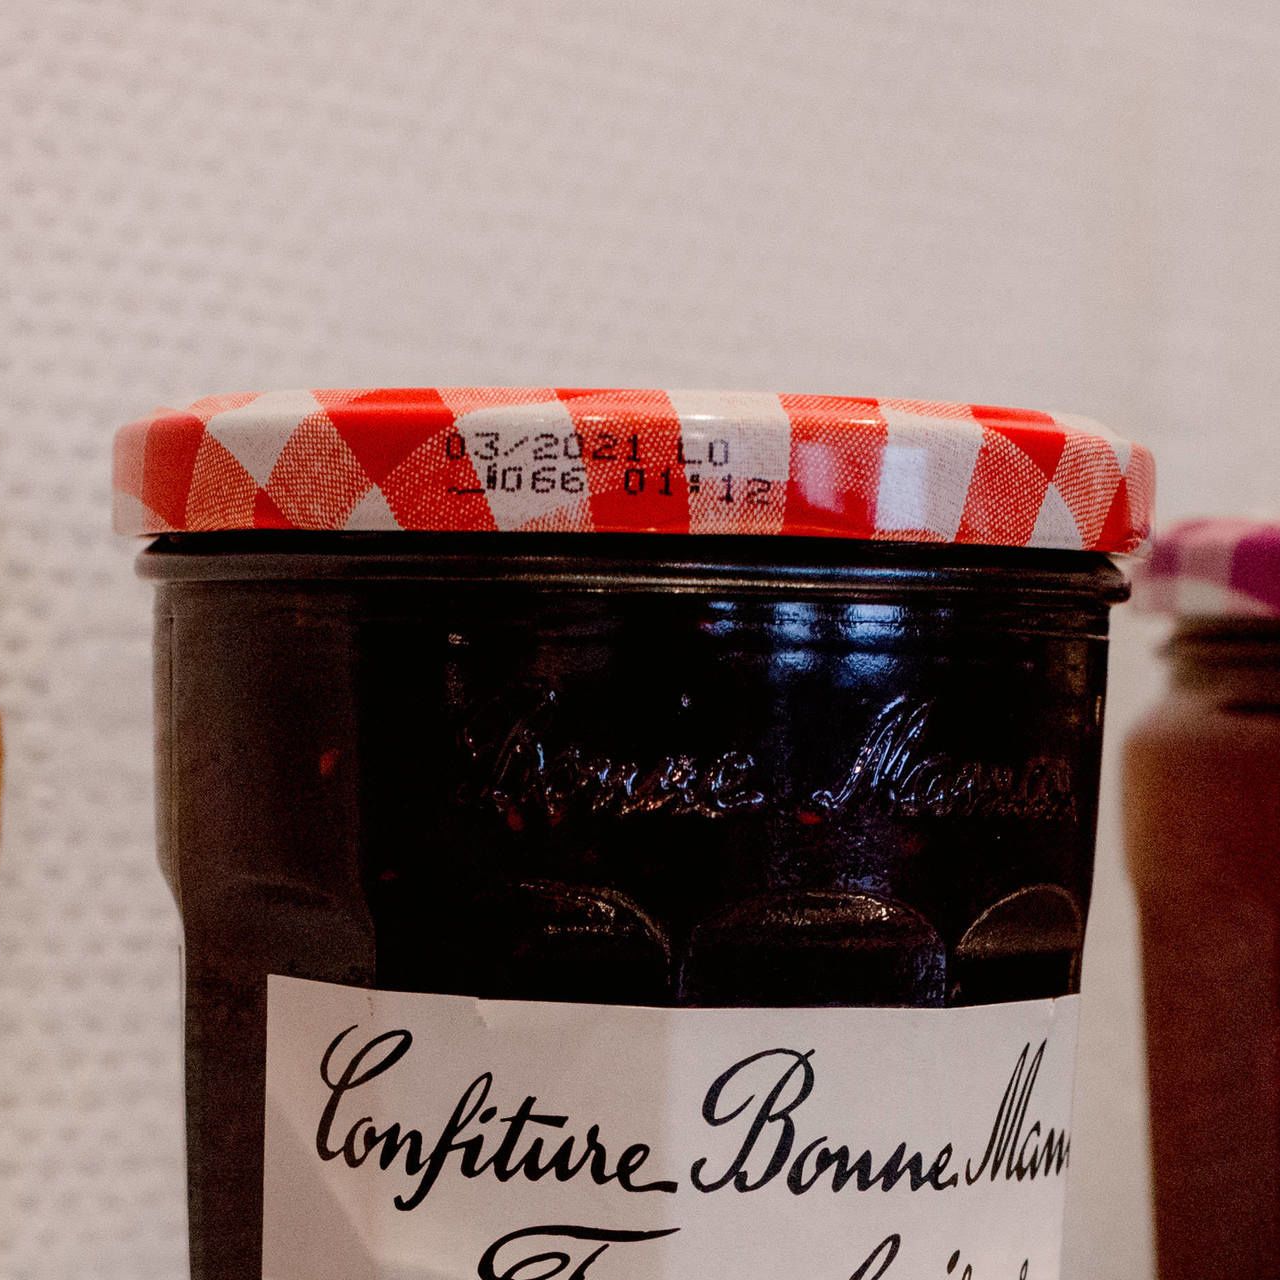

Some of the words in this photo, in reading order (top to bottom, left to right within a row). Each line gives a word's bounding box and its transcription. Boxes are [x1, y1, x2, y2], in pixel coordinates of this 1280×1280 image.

[446, 432, 641, 463] 03/2021
[317, 1024, 677, 1211] Confiture
[690, 1048, 958, 1195] Bonne
